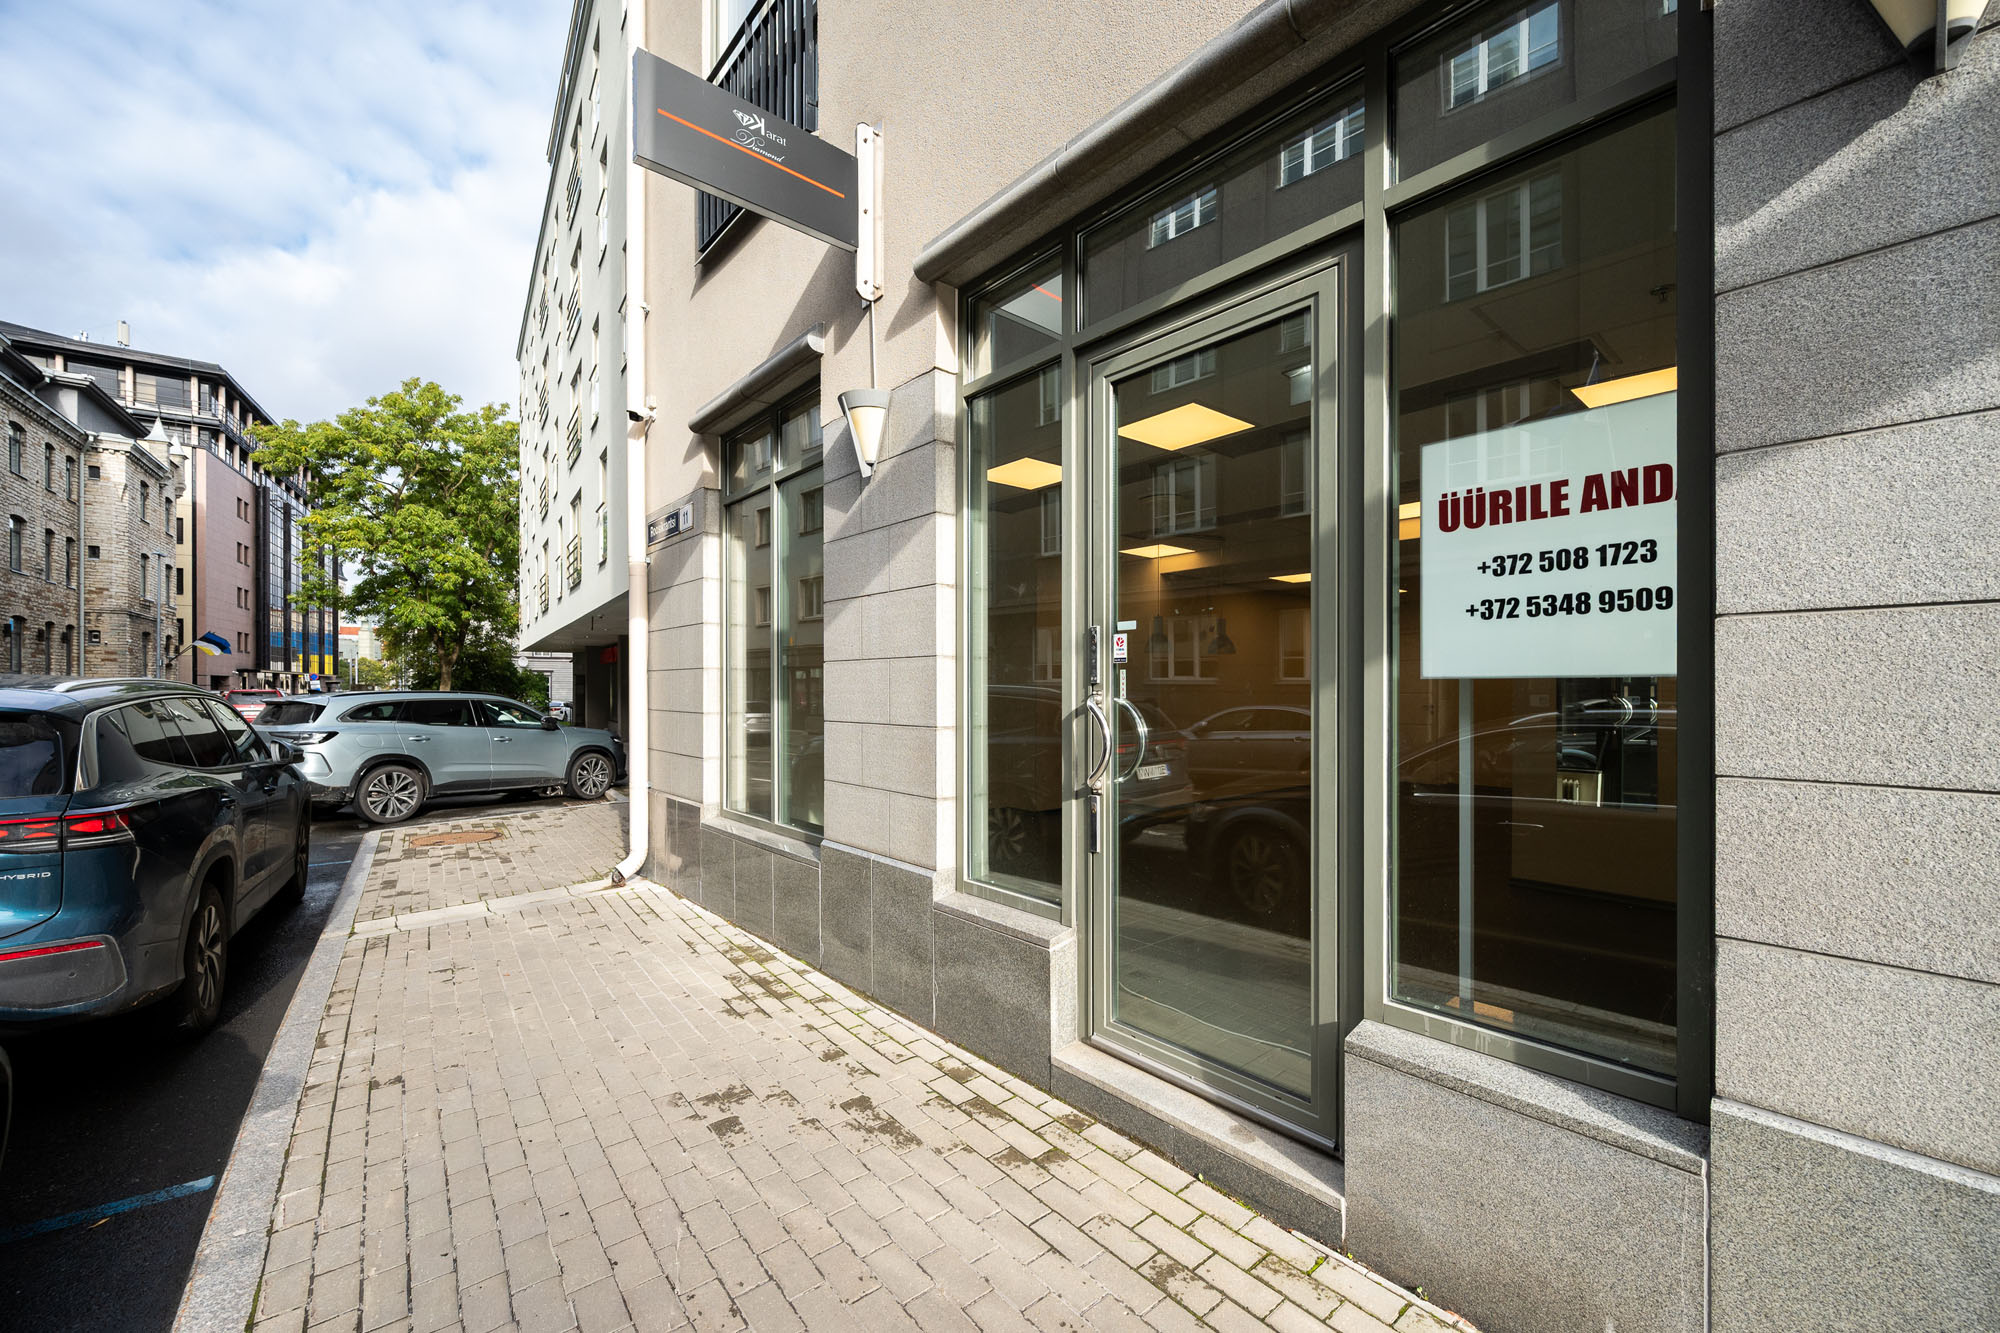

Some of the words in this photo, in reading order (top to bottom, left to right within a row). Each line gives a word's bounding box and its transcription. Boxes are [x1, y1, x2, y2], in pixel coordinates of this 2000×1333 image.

[729, 128, 785, 163] Diamond
[1438, 478, 1570, 533] ÜÜRILE
[1579, 463, 1677, 514] AND
[682, 510, 689, 525] 11
[1477, 552, 1533, 577] +372
[1538, 546, 1589, 573] 508
[1595, 539, 1658, 567] 1723
[1465, 596, 1520, 620] +372
[1526, 591, 1591, 618] 5348
[1598, 585, 1674, 613] 9509
